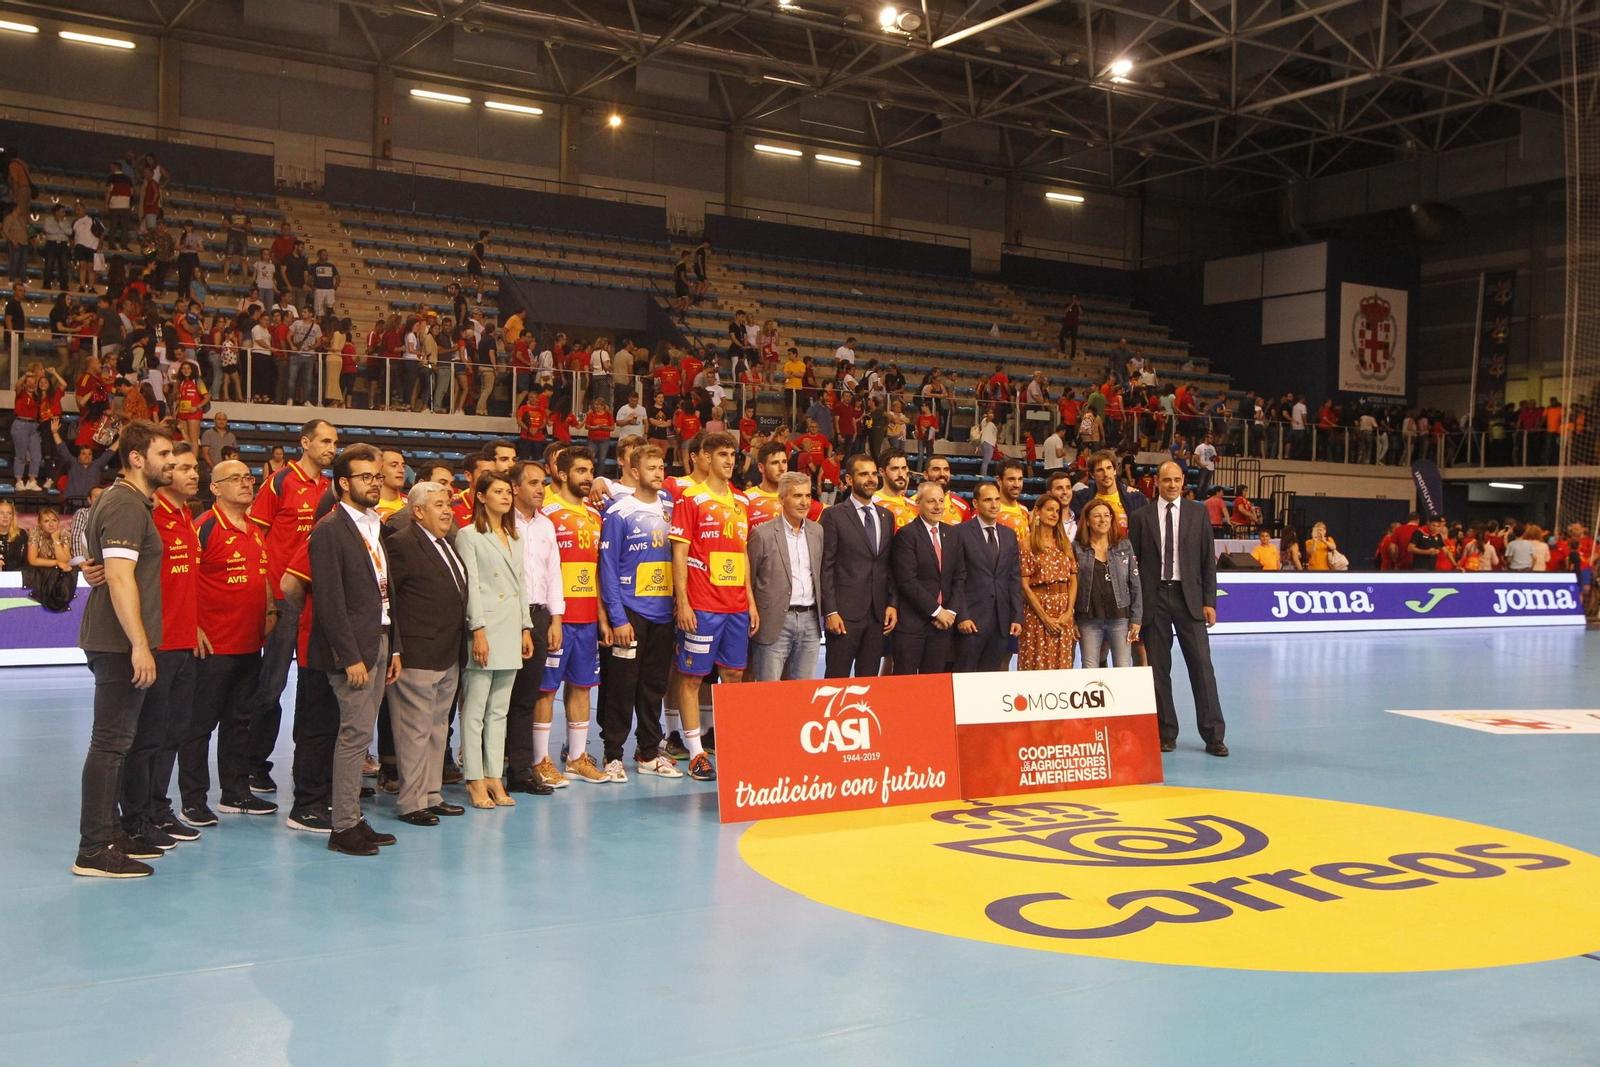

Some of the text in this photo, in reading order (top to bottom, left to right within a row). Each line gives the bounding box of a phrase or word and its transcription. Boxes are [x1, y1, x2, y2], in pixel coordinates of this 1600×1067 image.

[626, 532, 648, 540] Santander
[701, 530, 720, 539] AVIS
[722, 522, 734, 539] 40
[559, 540, 573, 549] VIS
[577, 529, 591, 550] 53
[651, 529, 664, 548] 33
[628, 542, 648, 551] AVIS
[170, 564, 189, 574] AVIS
[227, 575, 248, 584] AVIS
[570, 585, 593, 593] Correos
[644, 584, 669, 592] Correos
[800, 717, 871, 754] CASI
[1095, 728, 1104, 741] la
[842, 752, 881, 763] 1944-2019
[1018, 742, 1105, 761] COOPERATIVA
[1030, 756, 1106, 772] AGRICULTORES
[1019, 767, 1107, 786] ALMERIENSES
[735, 765, 946, 808] tradición con futuro
[985, 843, 1570, 939] Correos
